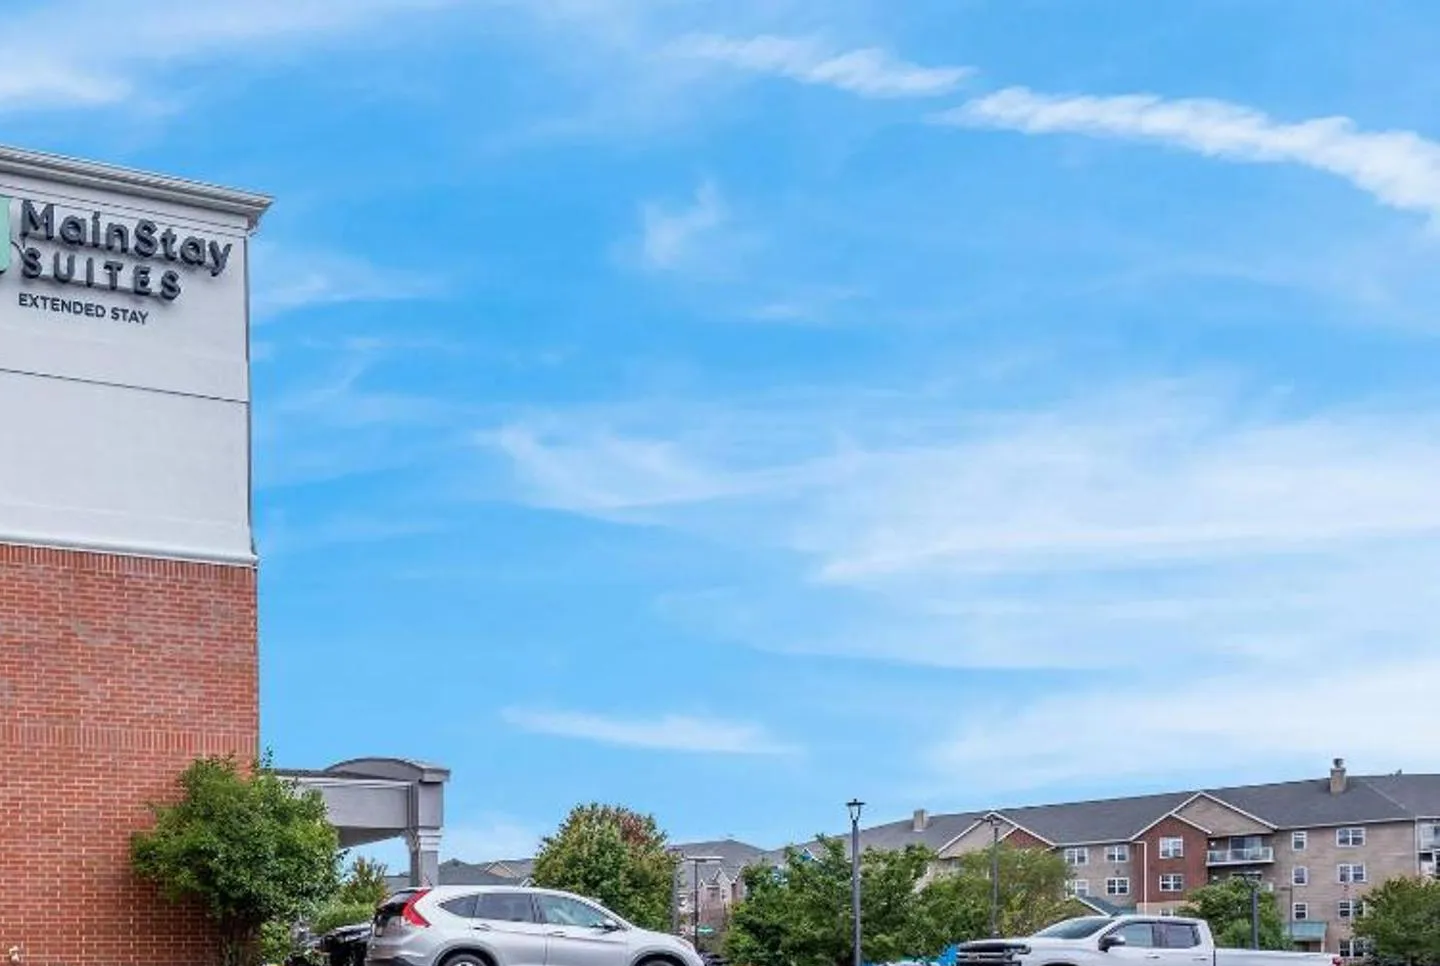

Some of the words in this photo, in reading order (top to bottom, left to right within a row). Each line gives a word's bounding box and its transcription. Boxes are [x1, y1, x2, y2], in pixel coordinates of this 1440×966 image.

[21, 199, 232, 277] MainStay
[22, 246, 182, 301] SUITES
[18, 292, 106, 319] EXTENDED
[111, 308, 149, 325] STAY
